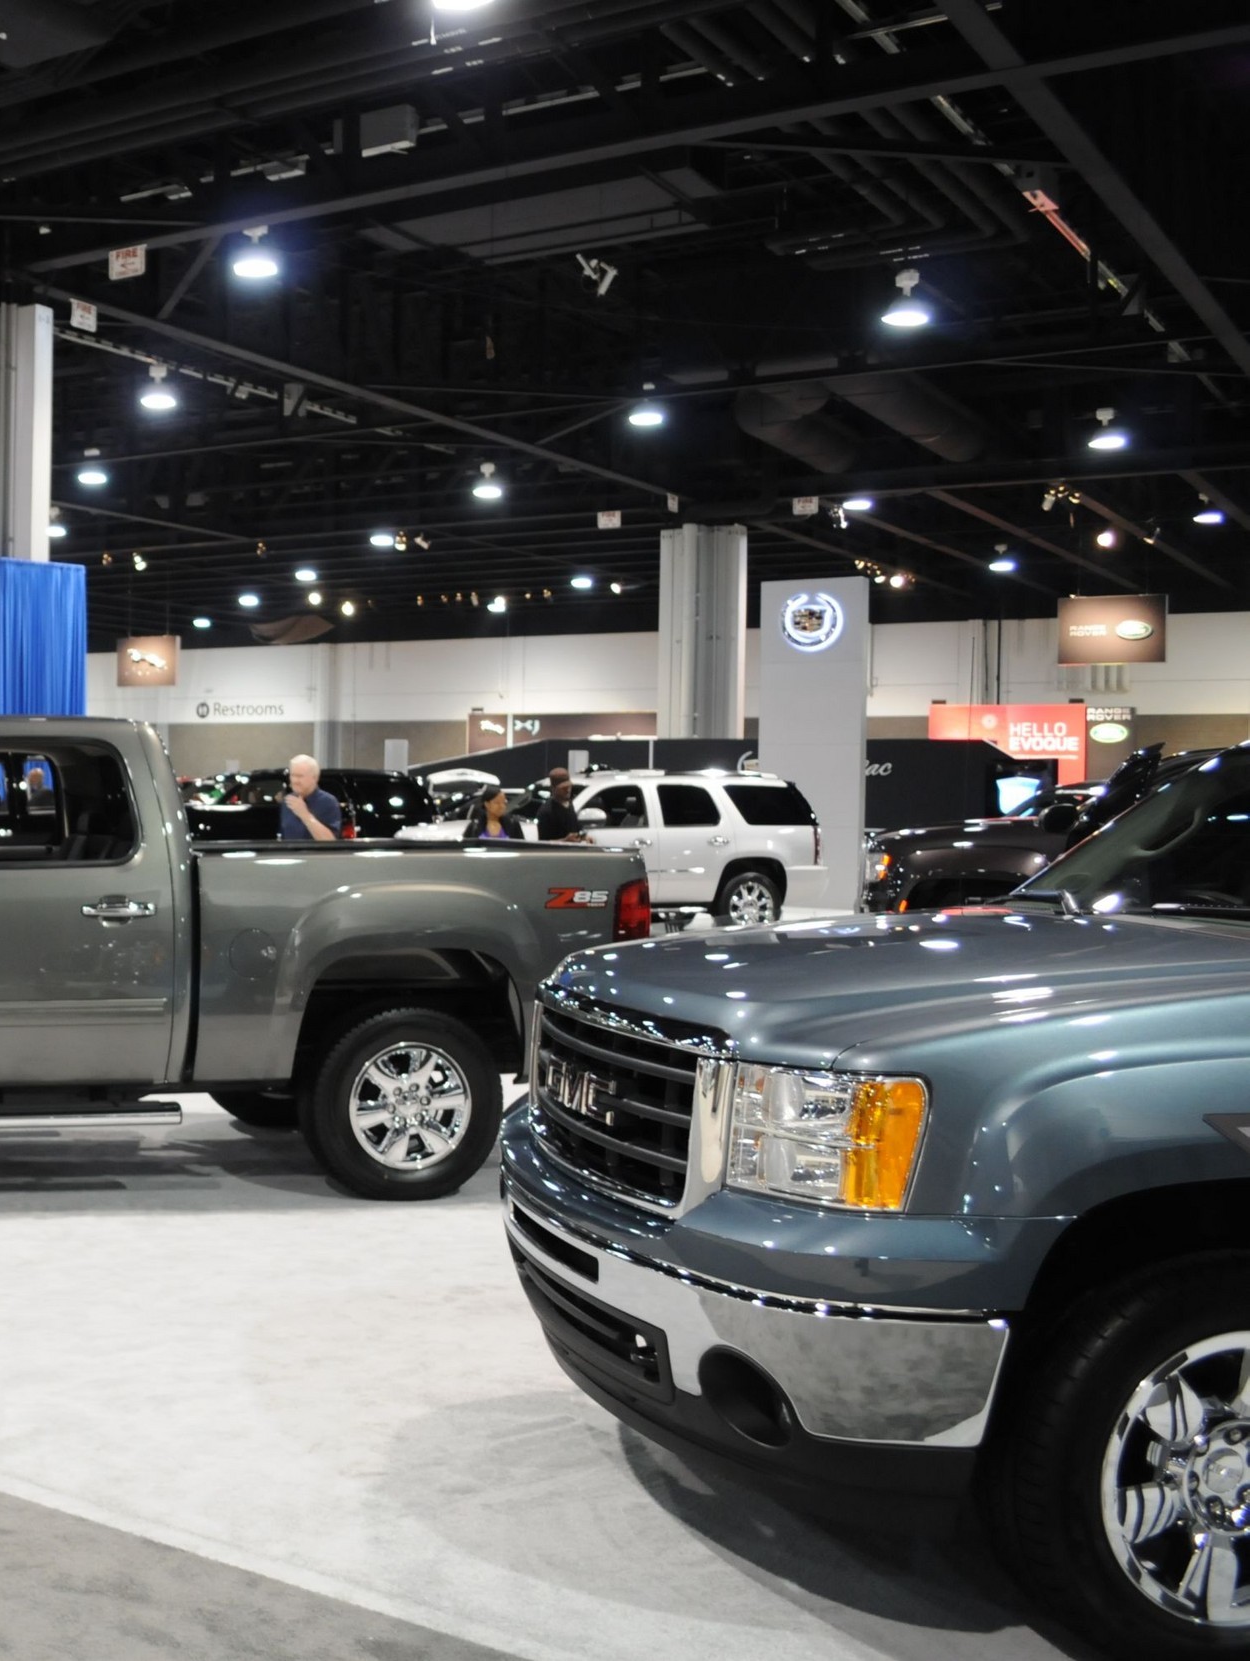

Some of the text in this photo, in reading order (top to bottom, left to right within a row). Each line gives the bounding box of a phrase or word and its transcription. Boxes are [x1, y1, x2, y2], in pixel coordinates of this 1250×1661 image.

[114, 247, 139, 261] FIRE
[213, 702, 284, 717] Restrooms
[1086, 707, 1132, 715] RANGE
[1009, 722, 1067, 737] HELLO
[1009, 736, 1079, 752] EVOQUE
[545, 887, 609, 909] Z85
[546, 1055, 616, 1126] GMC
